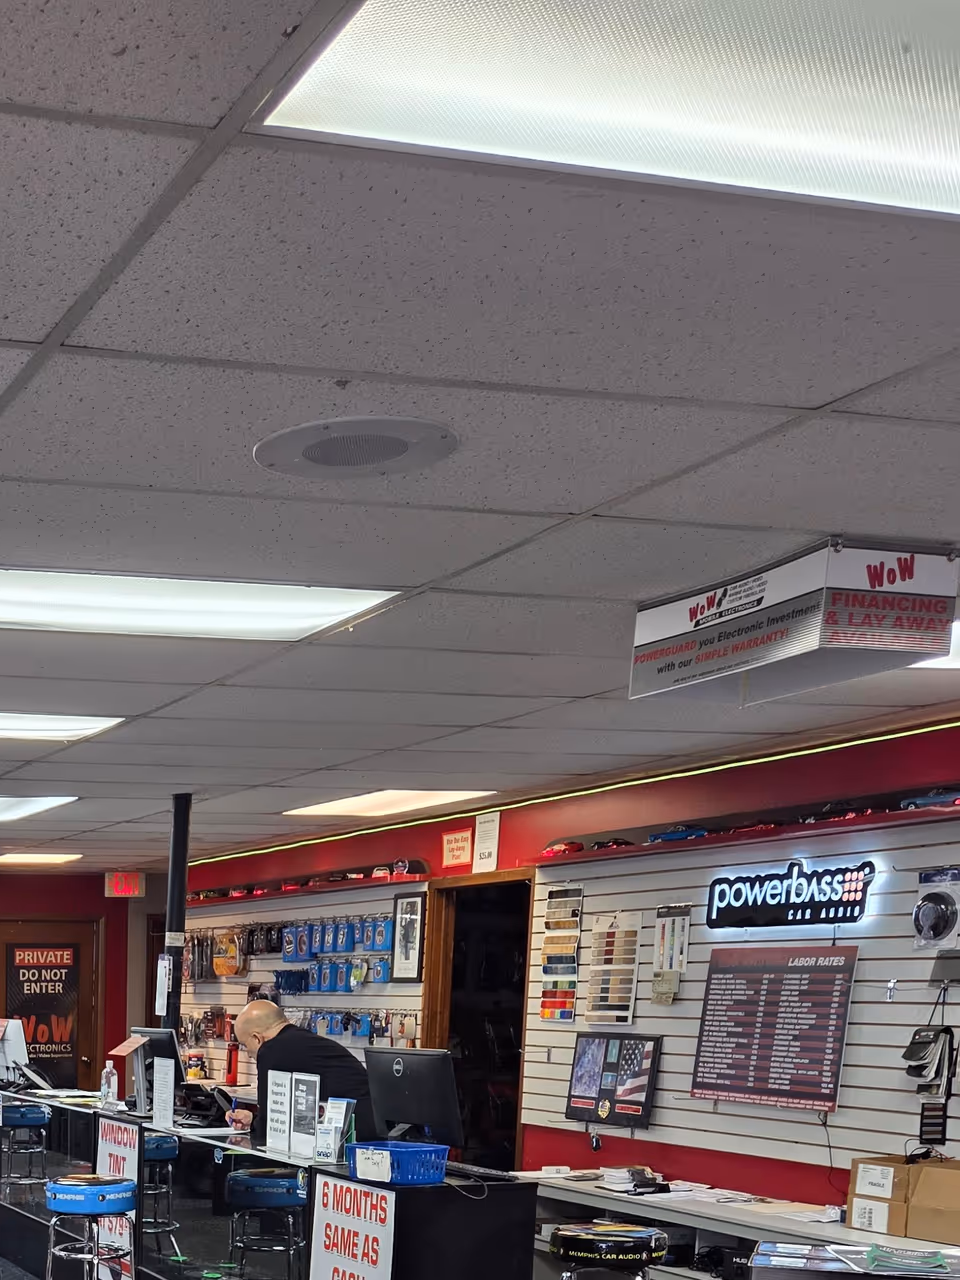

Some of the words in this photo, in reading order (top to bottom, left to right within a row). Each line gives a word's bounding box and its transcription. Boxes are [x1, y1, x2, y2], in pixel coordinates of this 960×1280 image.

[866, 554, 915, 589] WoW
[688, 591, 717, 623] WoW
[700, 612, 720, 624] MOBILE
[722, 601, 758, 616] ELECTRONICS
[830, 592, 948, 615] FINANCING
[633, 639, 697, 665] POWERGUARD
[698, 637, 716, 651] you
[717, 622, 764, 642] Electronic
[766, 601, 820, 628] Investment
[825, 612, 840, 627] &
[847, 612, 887, 629] LAY
[893, 616, 951, 632] AWAY
[656, 662, 676, 675] with
[678, 659, 694, 670] our
[695, 648, 729, 665] SIMPLE
[731, 628, 790, 654] WARRANTY!
[787, 909, 811, 921] CAR
[819, 905, 861, 919] AUDIO
[15, 951, 71, 964] PRIVATE
[788, 956, 816, 967] LABOR
[816, 956, 846, 967] RATES
[19, 969, 39, 981] DO
[41, 969, 68, 981] NOT
[23, 982, 63, 994] ENTER
[100, 1121, 138, 1149] WINDOW
[108, 1153, 127, 1177] TINT
[316, 1150, 333, 1159] snap!
[55, 1193, 85, 1201] MEMPHIS
[106, 1192, 133, 1200] MEMPHIS
[321, 1180, 330, 1209] 6
[332, 1182, 388, 1226] MONTHS
[323, 1222, 359, 1261] SAME
[360, 1234, 379, 1268] AS
[568, 1250, 600, 1259] MEMPHIS
[601, 1252, 617, 1260] CAR
[618, 1252, 641, 1261] AUDIO
